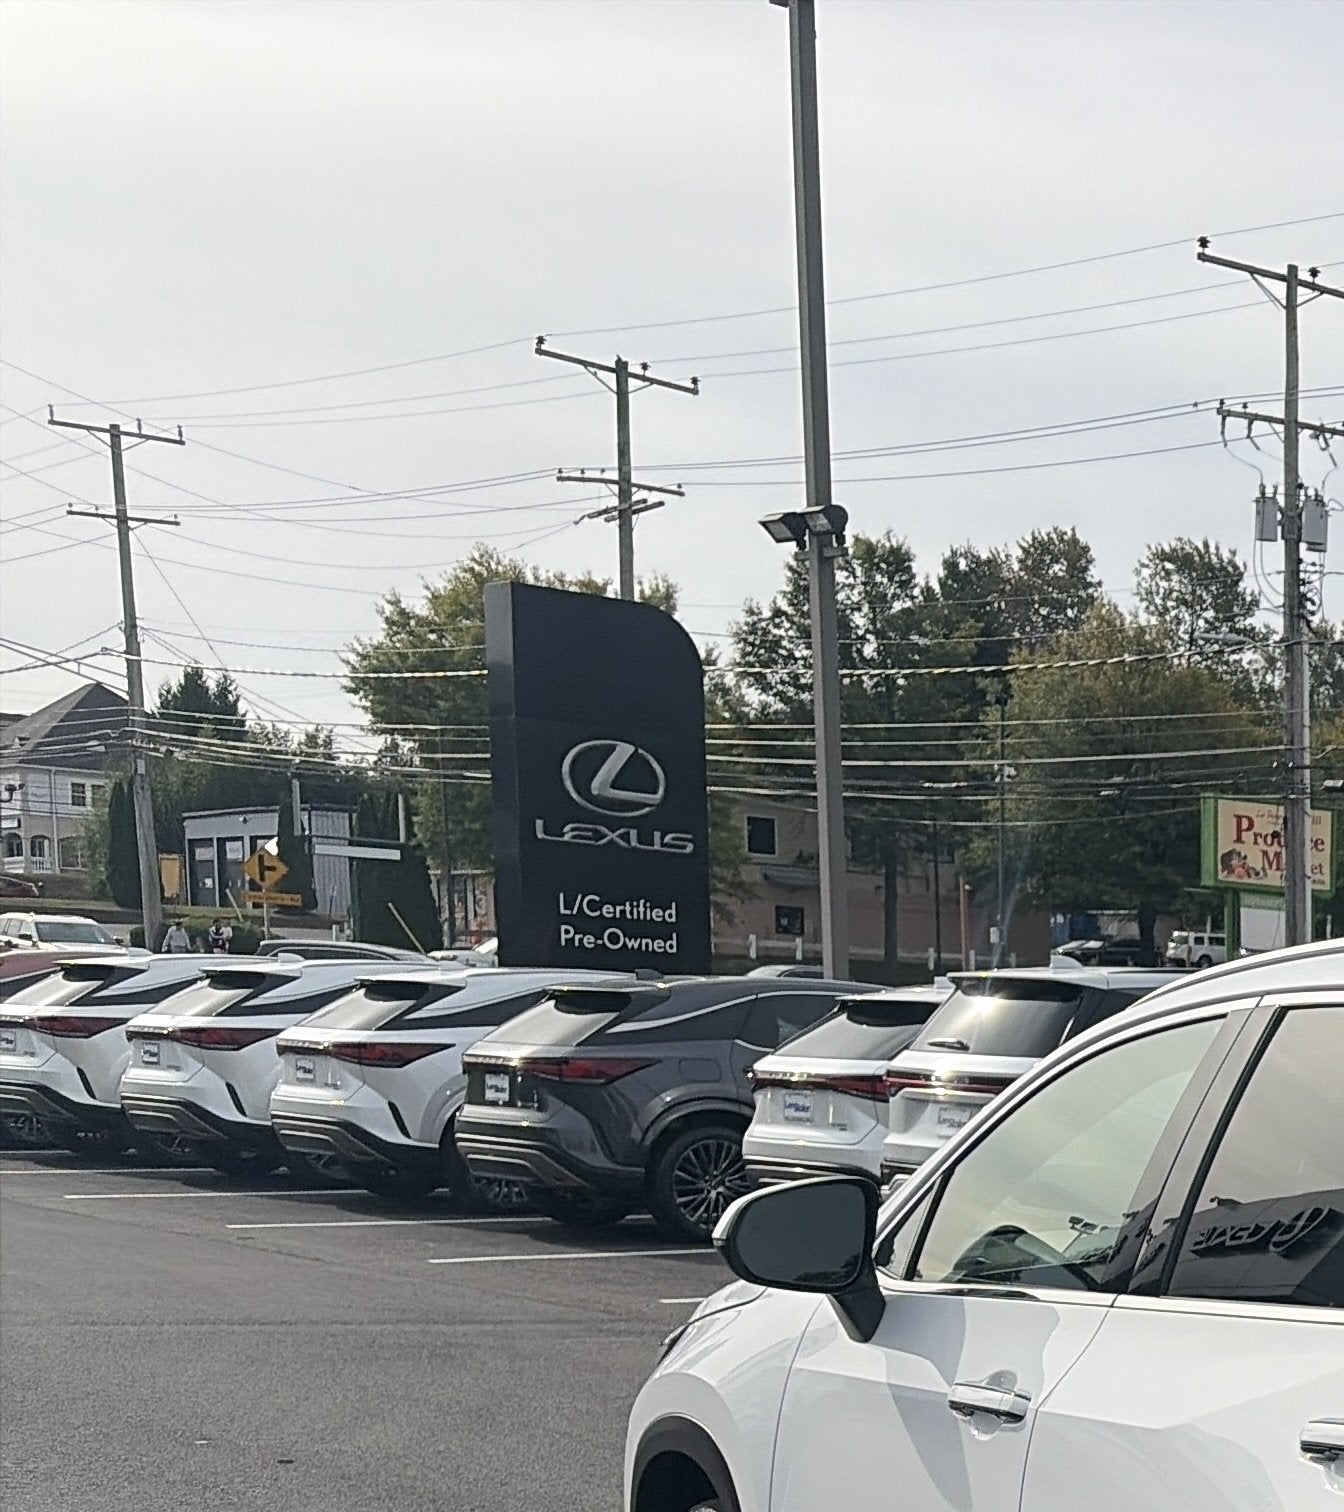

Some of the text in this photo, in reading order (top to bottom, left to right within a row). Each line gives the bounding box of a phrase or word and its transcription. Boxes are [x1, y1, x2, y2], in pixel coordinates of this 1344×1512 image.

[535, 818, 695, 854] LEXUS
[559, 892, 677, 923] L/Certified
[560, 924, 678, 954] Pre-Owned
